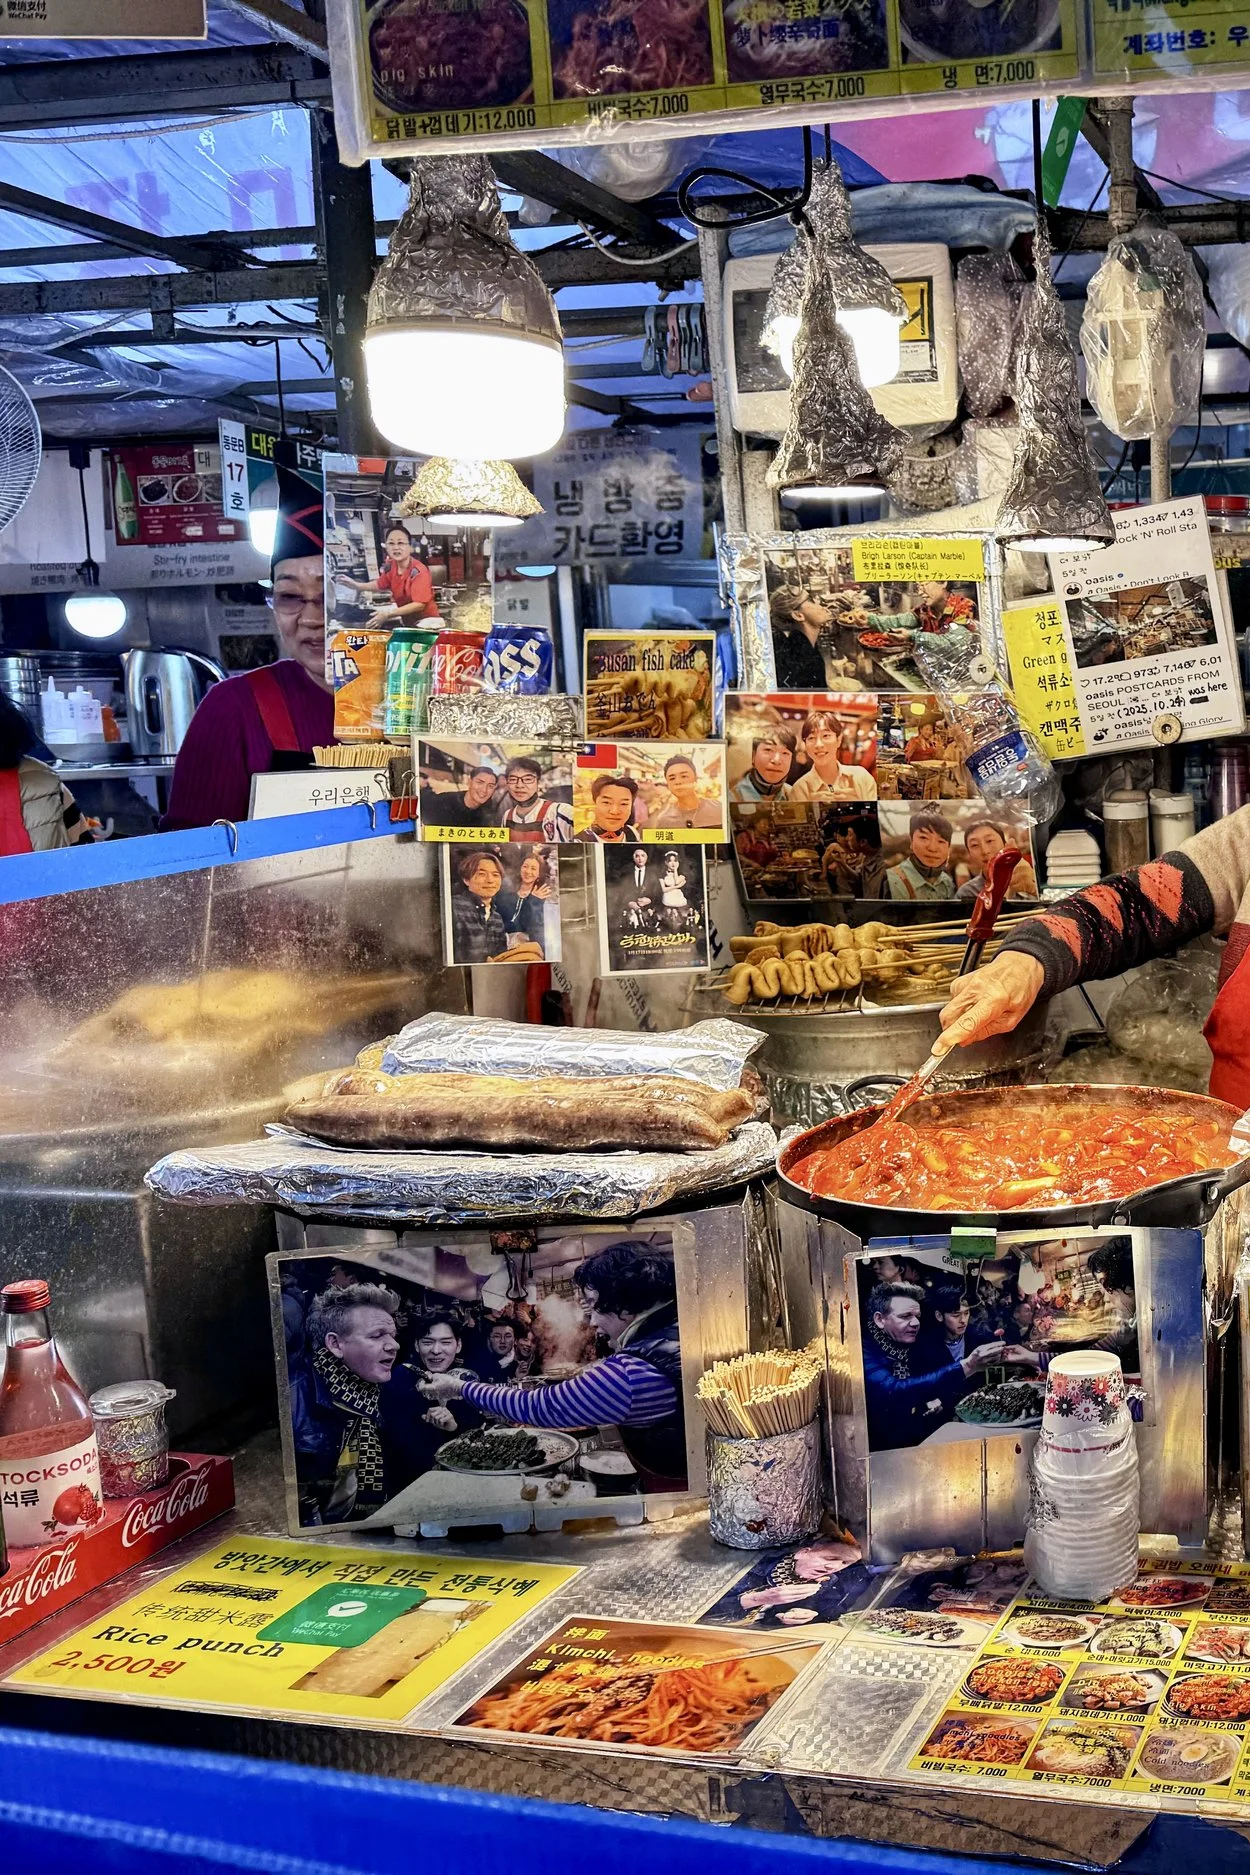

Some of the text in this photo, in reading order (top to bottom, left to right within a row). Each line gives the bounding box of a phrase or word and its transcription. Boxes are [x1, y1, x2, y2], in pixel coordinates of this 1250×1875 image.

[226, 462, 244, 482] 17
[554, 480, 584, 516] 냉
[603, 475, 634, 514] 방
[553, 520, 685, 559] 카드환영
[1156, 526, 1177, 537] Roll
[883, 552, 906, 560] Larson
[909, 552, 938, 562] (Captain
[1085, 575, 1115, 585] oasis
[642, 648, 665, 671] fish
[669, 649, 696, 670] cake
[1023, 654, 1057, 669] Green
[1085, 670, 1220, 700] oasis POSTCARDS FROM
[1208, 682, 1228, 693] here
[1088, 700, 1124, 711] SEOUL
[308, 784, 370, 806] 우리은행
[437, 827, 508, 840] まきのともあき
[213, 1551, 541, 1598] 방앗간에서 직접 만든 전통식혜
[92, 1625, 286, 1659] Rice punch
[50, 1650, 190, 1682] 2,500원
[545, 1643, 706, 1670] Kimchi noodles
[520, 1680, 595, 1700] 비빔국수
[977, 1766, 1007, 1777] 7,000
[1149, 1783, 1206, 1796] 냉면:7000
